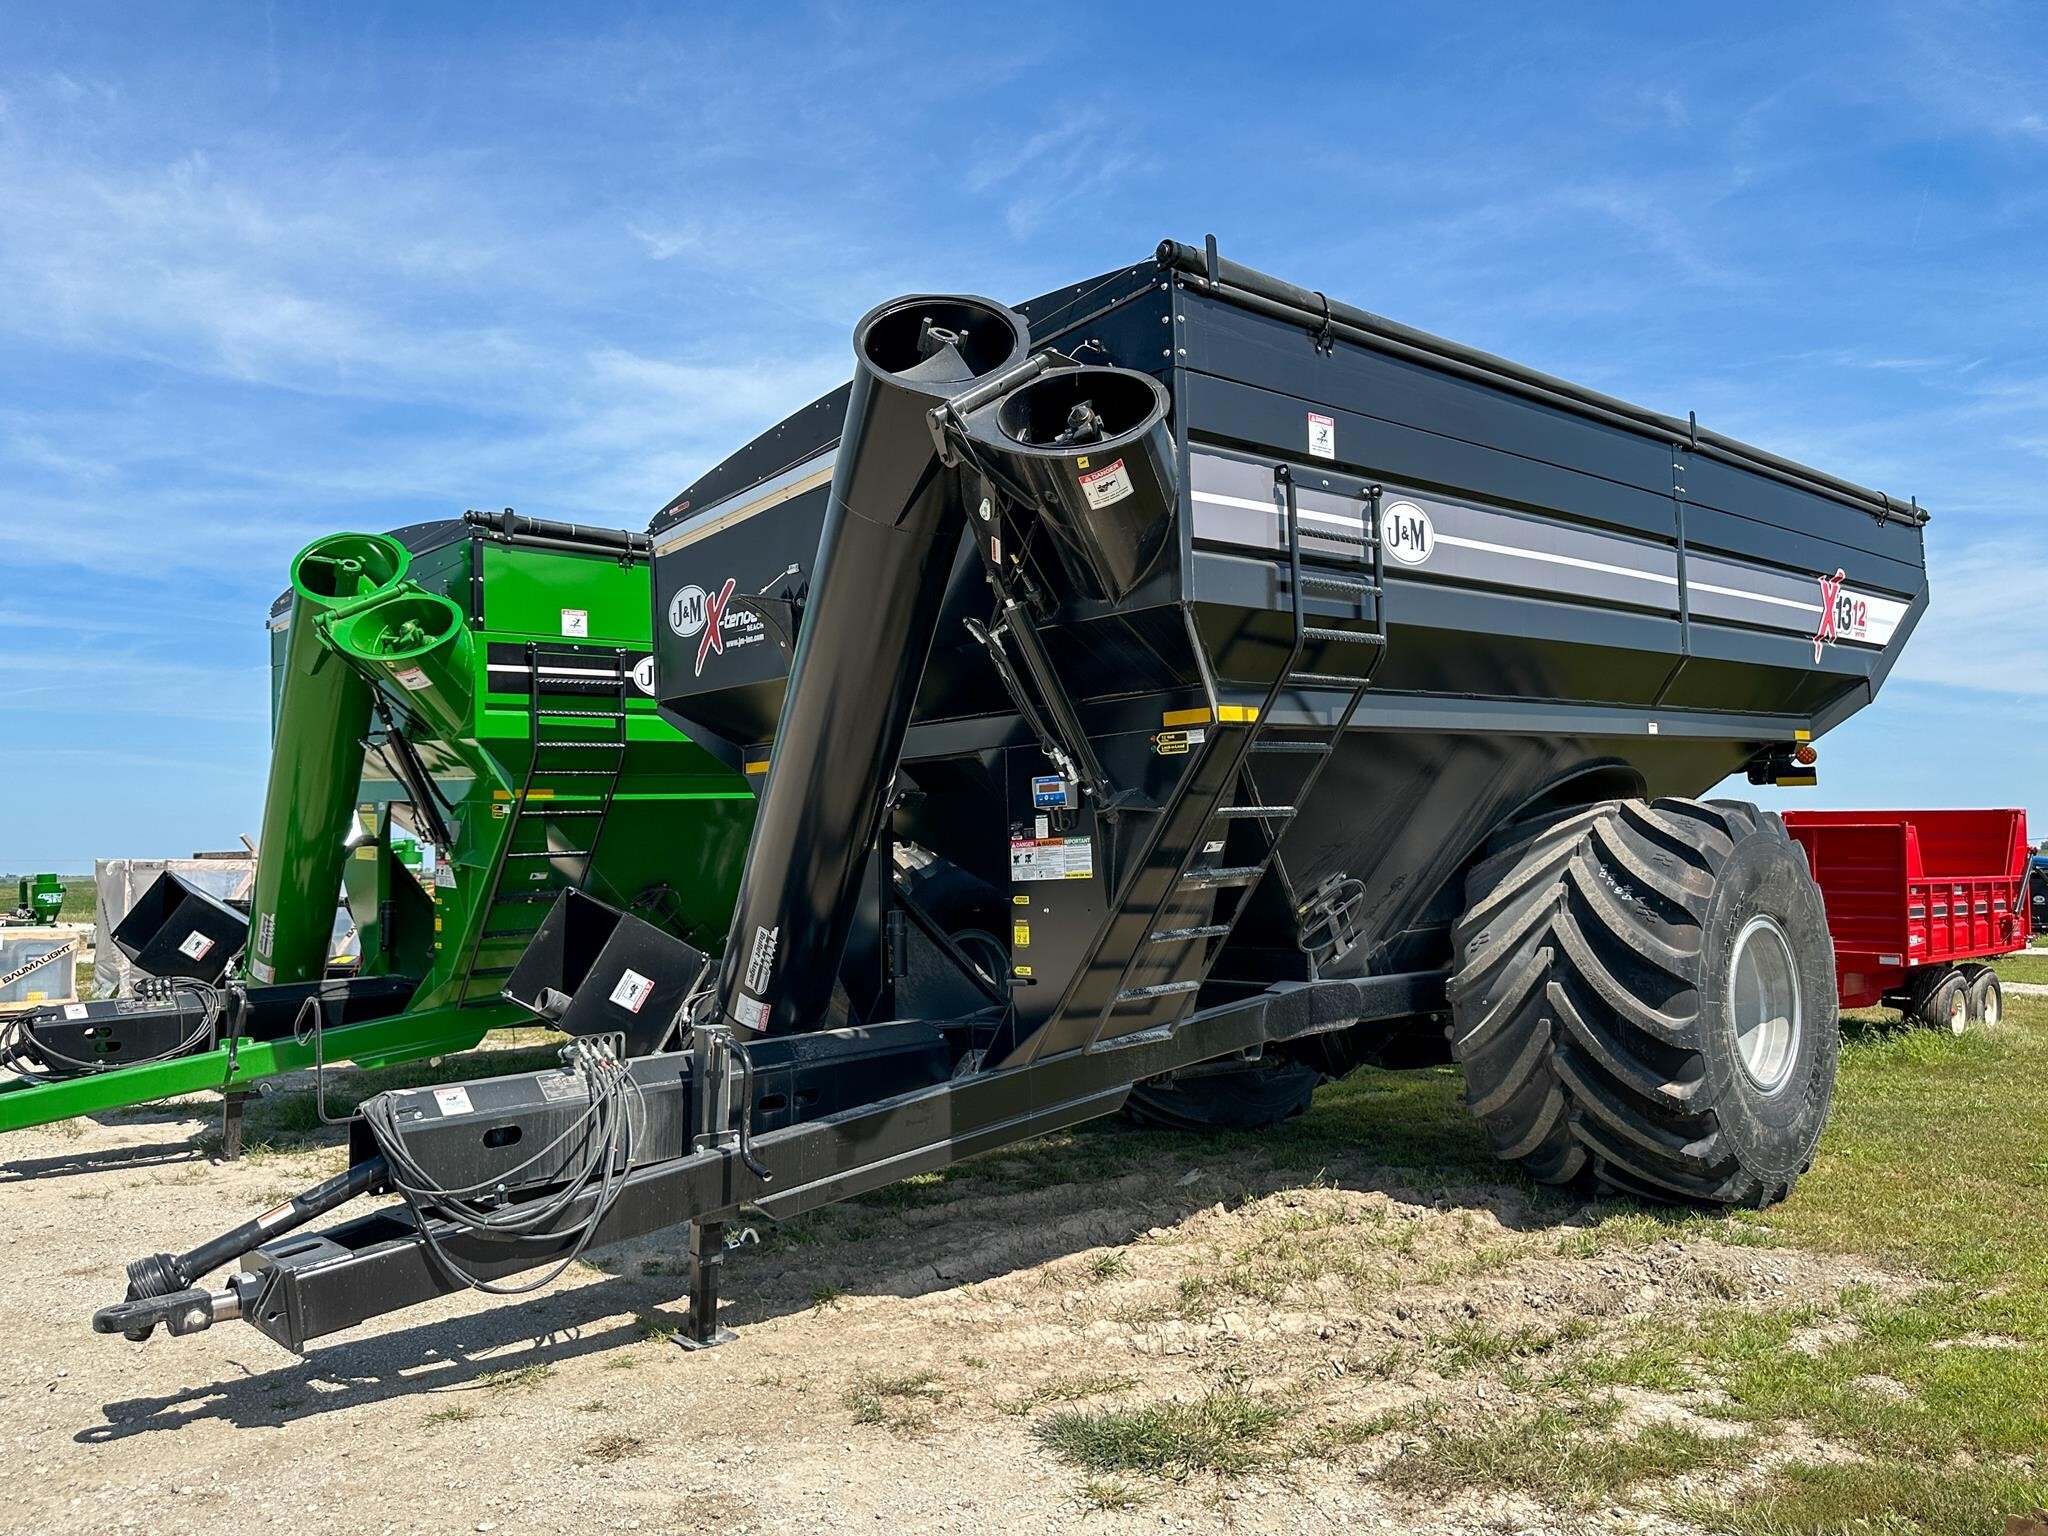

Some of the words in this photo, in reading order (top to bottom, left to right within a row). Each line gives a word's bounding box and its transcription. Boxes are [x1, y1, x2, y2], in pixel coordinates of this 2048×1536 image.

[1091, 463, 1119, 480] DANGER
[1387, 514, 1425, 552] J&M
[673, 595, 702, 628] J&M
[1064, 837, 1091, 845] IMPORTANT
[756, 931, 766, 958] Bullet
[2, 944, 71, 984] BAUMALIGHT
[749, 959, 759, 985] Auger
